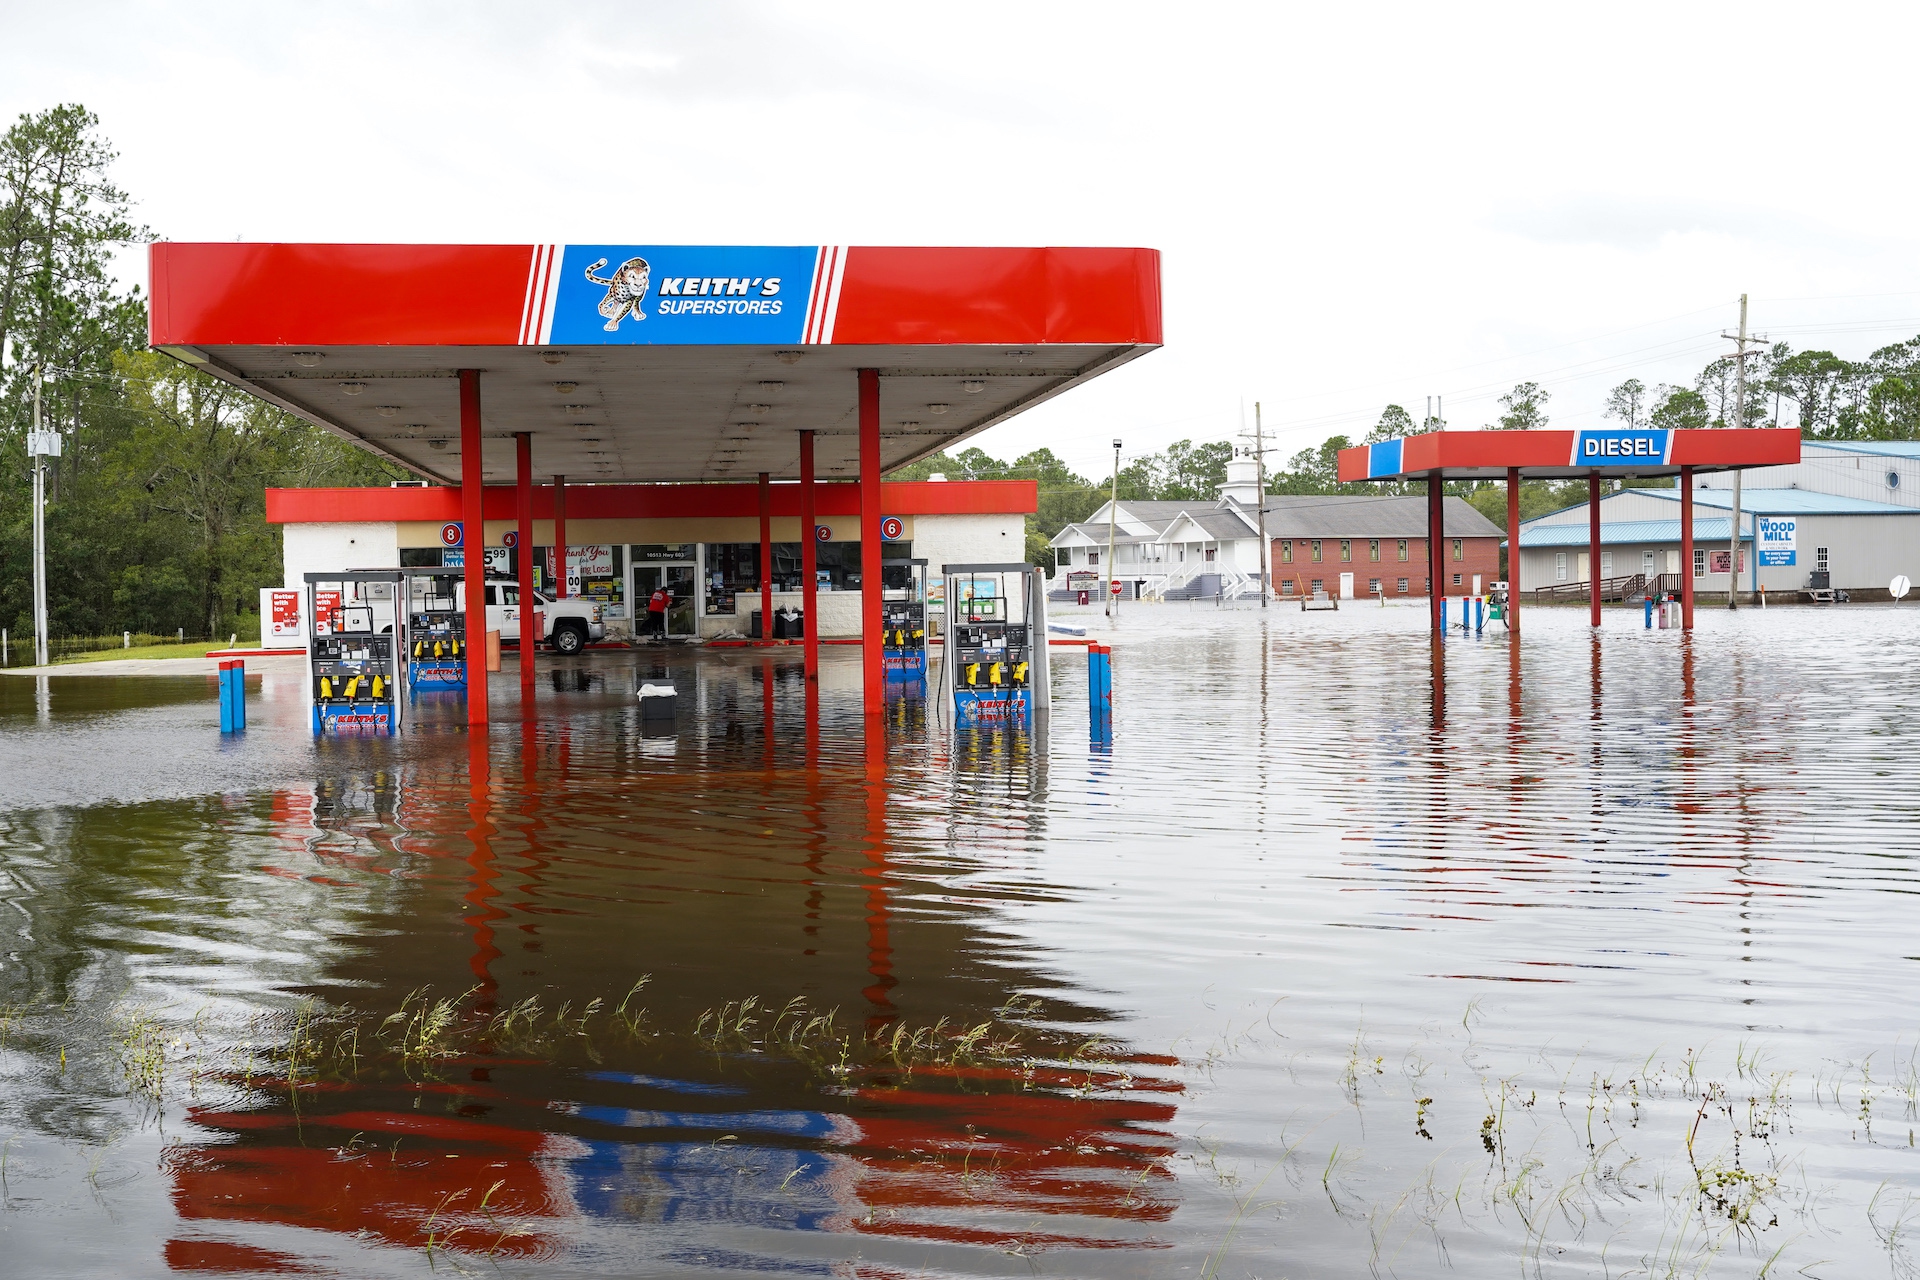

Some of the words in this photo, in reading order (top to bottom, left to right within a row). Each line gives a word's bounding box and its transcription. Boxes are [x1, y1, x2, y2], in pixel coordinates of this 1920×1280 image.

[658, 277, 782, 296] KEITH'S
[658, 300, 783, 315] SUPERSTORES
[1584, 438, 1661, 456] DIESEL
[888, 523, 896, 534] 6
[1760, 522, 1795, 532] WOOD
[447, 529, 455, 541] 8
[821, 529, 827, 538] 2
[1764, 532, 1792, 541] MILL
[505, 535, 512, 544] 4
[586, 546, 609, 561] You
[579, 557, 589, 565] for
[1717, 556, 1730, 564] WOO
[593, 565, 612, 573] Local
[337, 714, 389, 723] KEITH'S
